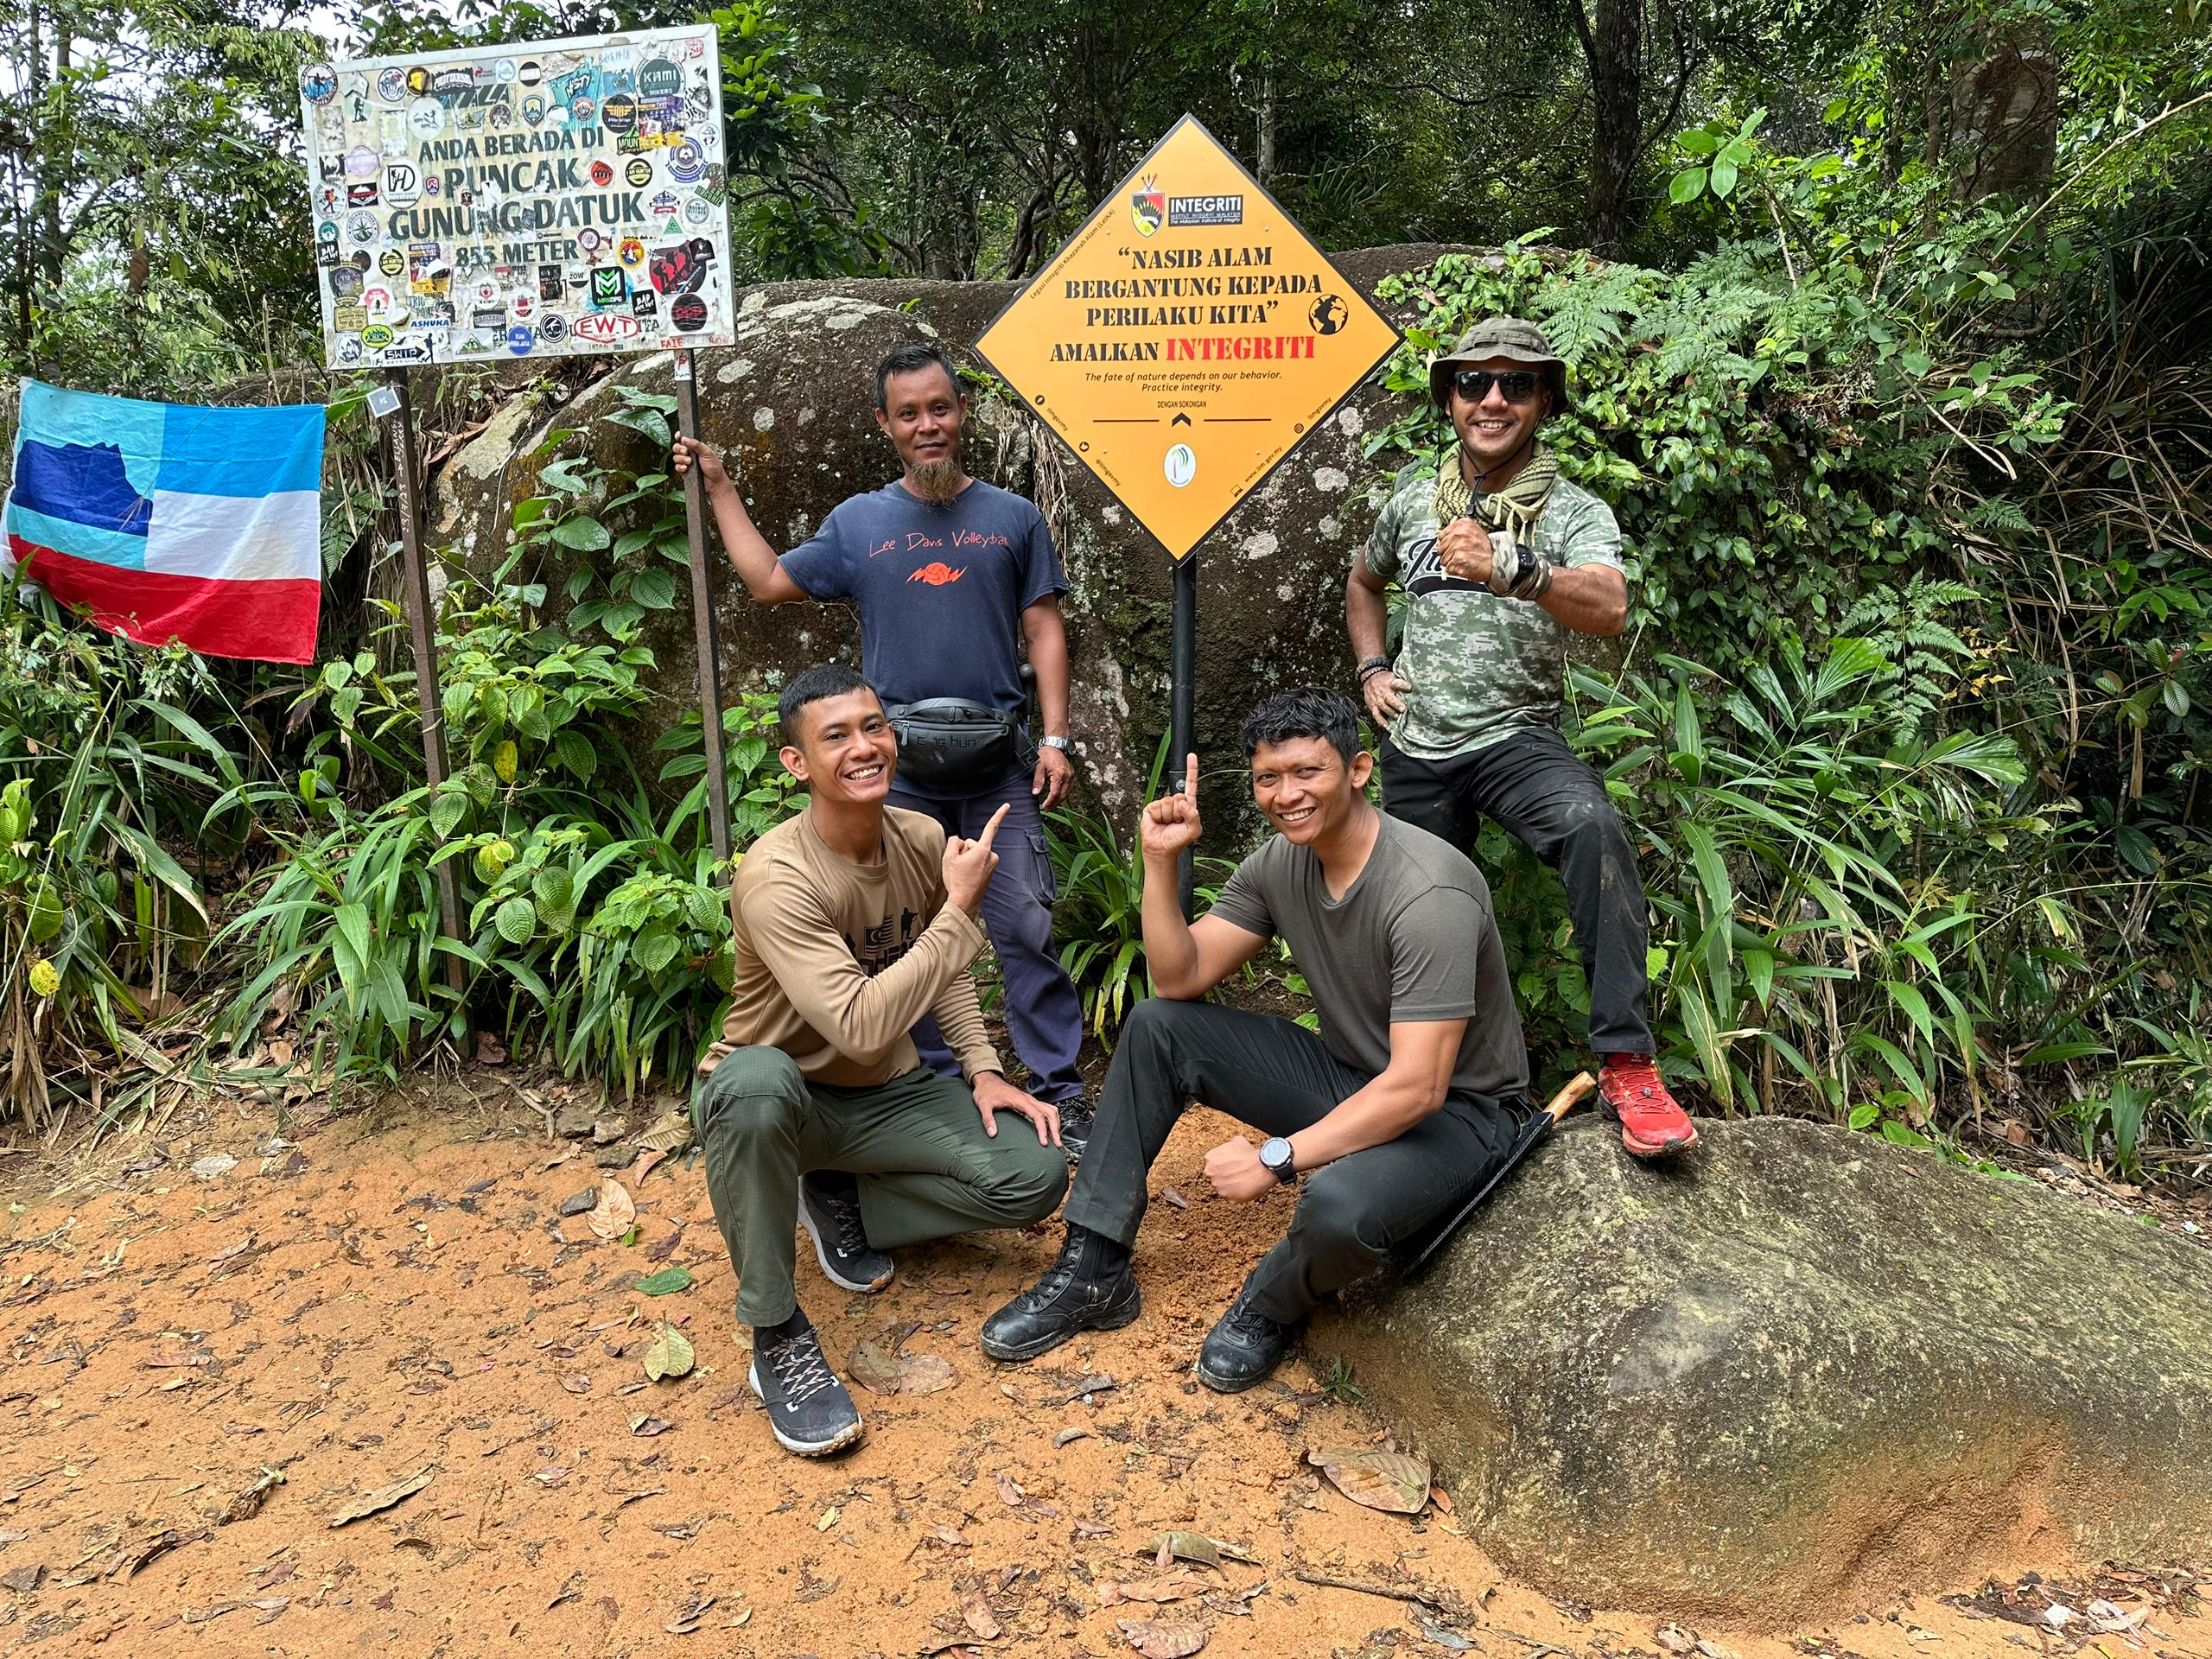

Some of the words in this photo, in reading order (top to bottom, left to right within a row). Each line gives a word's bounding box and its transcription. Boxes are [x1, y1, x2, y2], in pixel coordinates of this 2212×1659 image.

[419, 137, 480, 162] ANDA
[485, 130, 576, 157] BERADA
[582, 127, 604, 149] DI
[445, 157, 584, 199] PUNCAK
[533, 191, 645, 230] DATUK
[1171, 196, 1242, 213] INTEGRITI
[503, 239, 581, 264] METER
[1030, 283, 1046, 300] Legasi
[1046, 263, 1065, 285] Integriti
[1063, 238, 1087, 264] Khazanah
[1085, 226, 1099, 242] Alam
[1207, 246, 1273, 268] ALAM
[1065, 276, 1222, 299] BERGANTUNG
[1227, 274, 1323, 296] KEPADA
[410, 319, 449, 327] ASHUKA
[580, 317, 632, 334] EWT
[1086, 305, 1205, 327] PERILAKU
[1049, 342, 1160, 363] AMALKAN
[1166, 335, 1316, 361] INTEGRITI
[1084, 372, 1103, 381] The
[1103, 372, 1123, 383] fate
[1125, 372, 1135, 383] of
[1169, 372, 1206, 382] depends
[1239, 370, 1282, 380] behavior.
[1141, 383, 1179, 391] Practice
[1180, 383, 1224, 393] integrity.
[868, 538, 896, 558] Lee
[905, 531, 944, 551] Davis
